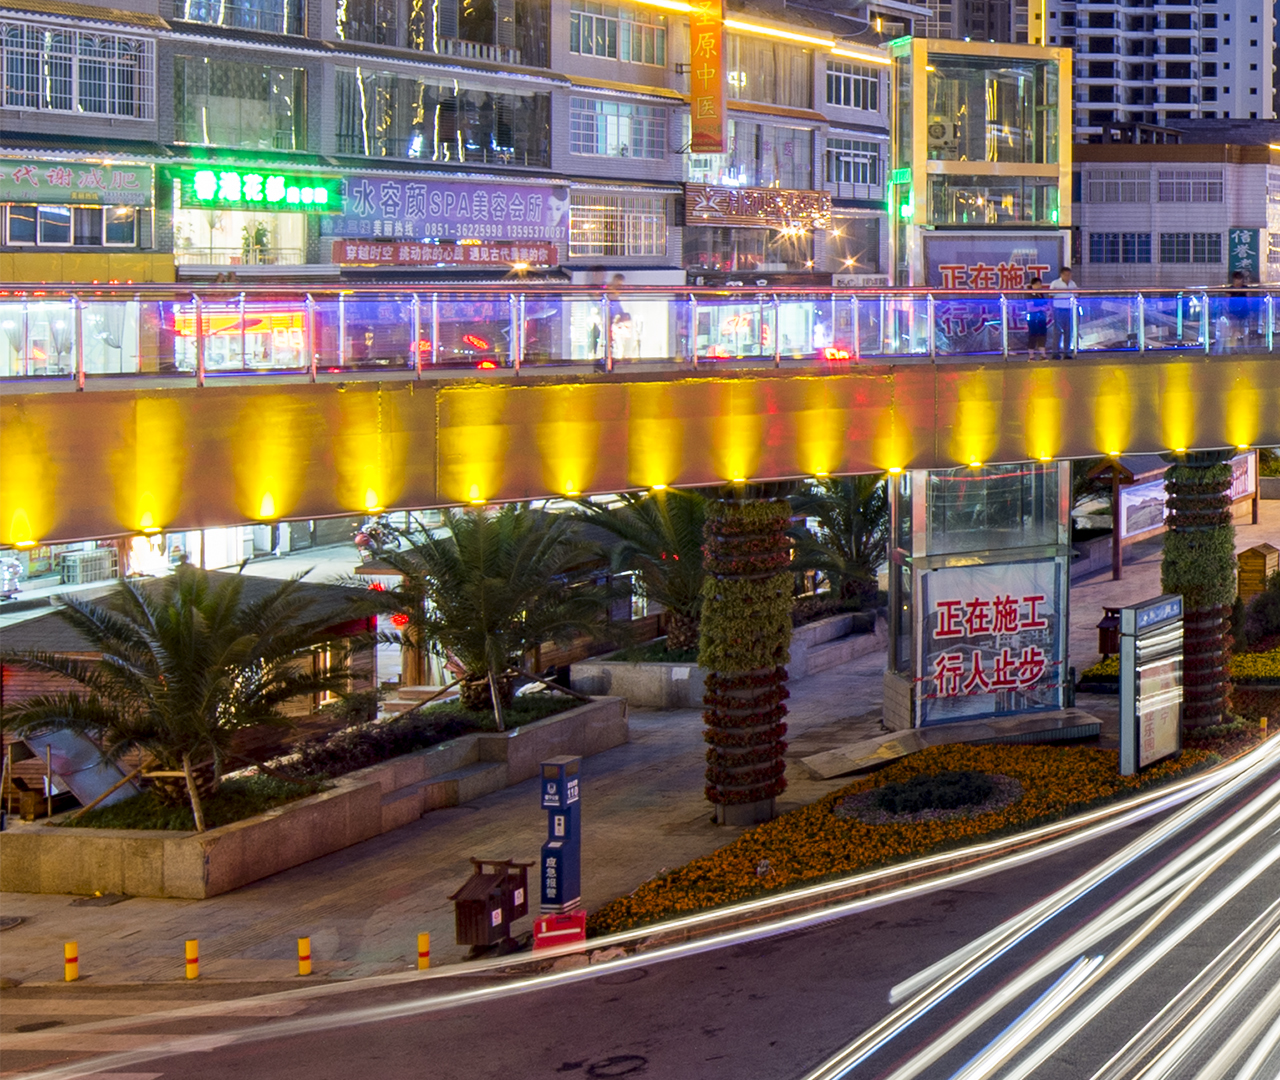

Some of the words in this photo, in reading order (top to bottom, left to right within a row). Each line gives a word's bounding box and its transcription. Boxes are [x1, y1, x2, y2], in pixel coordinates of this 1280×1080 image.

[693, 0, 717, 120] 圣原中医
[0, 165, 140, 190] 代谢减肥
[424, 225, 503, 238] 0851-36225998
[506, 225, 567, 239] 13595370087
[345, 244, 394, 260] 穿越时空
[938, 262, 1051, 290] 正在施工
[941, 304, 1054, 336] 行人止
[933, 594, 1049, 639] 正在施工
[934, 645, 1046, 696] 行人止步
[546, 857, 557, 899] 应急报警
